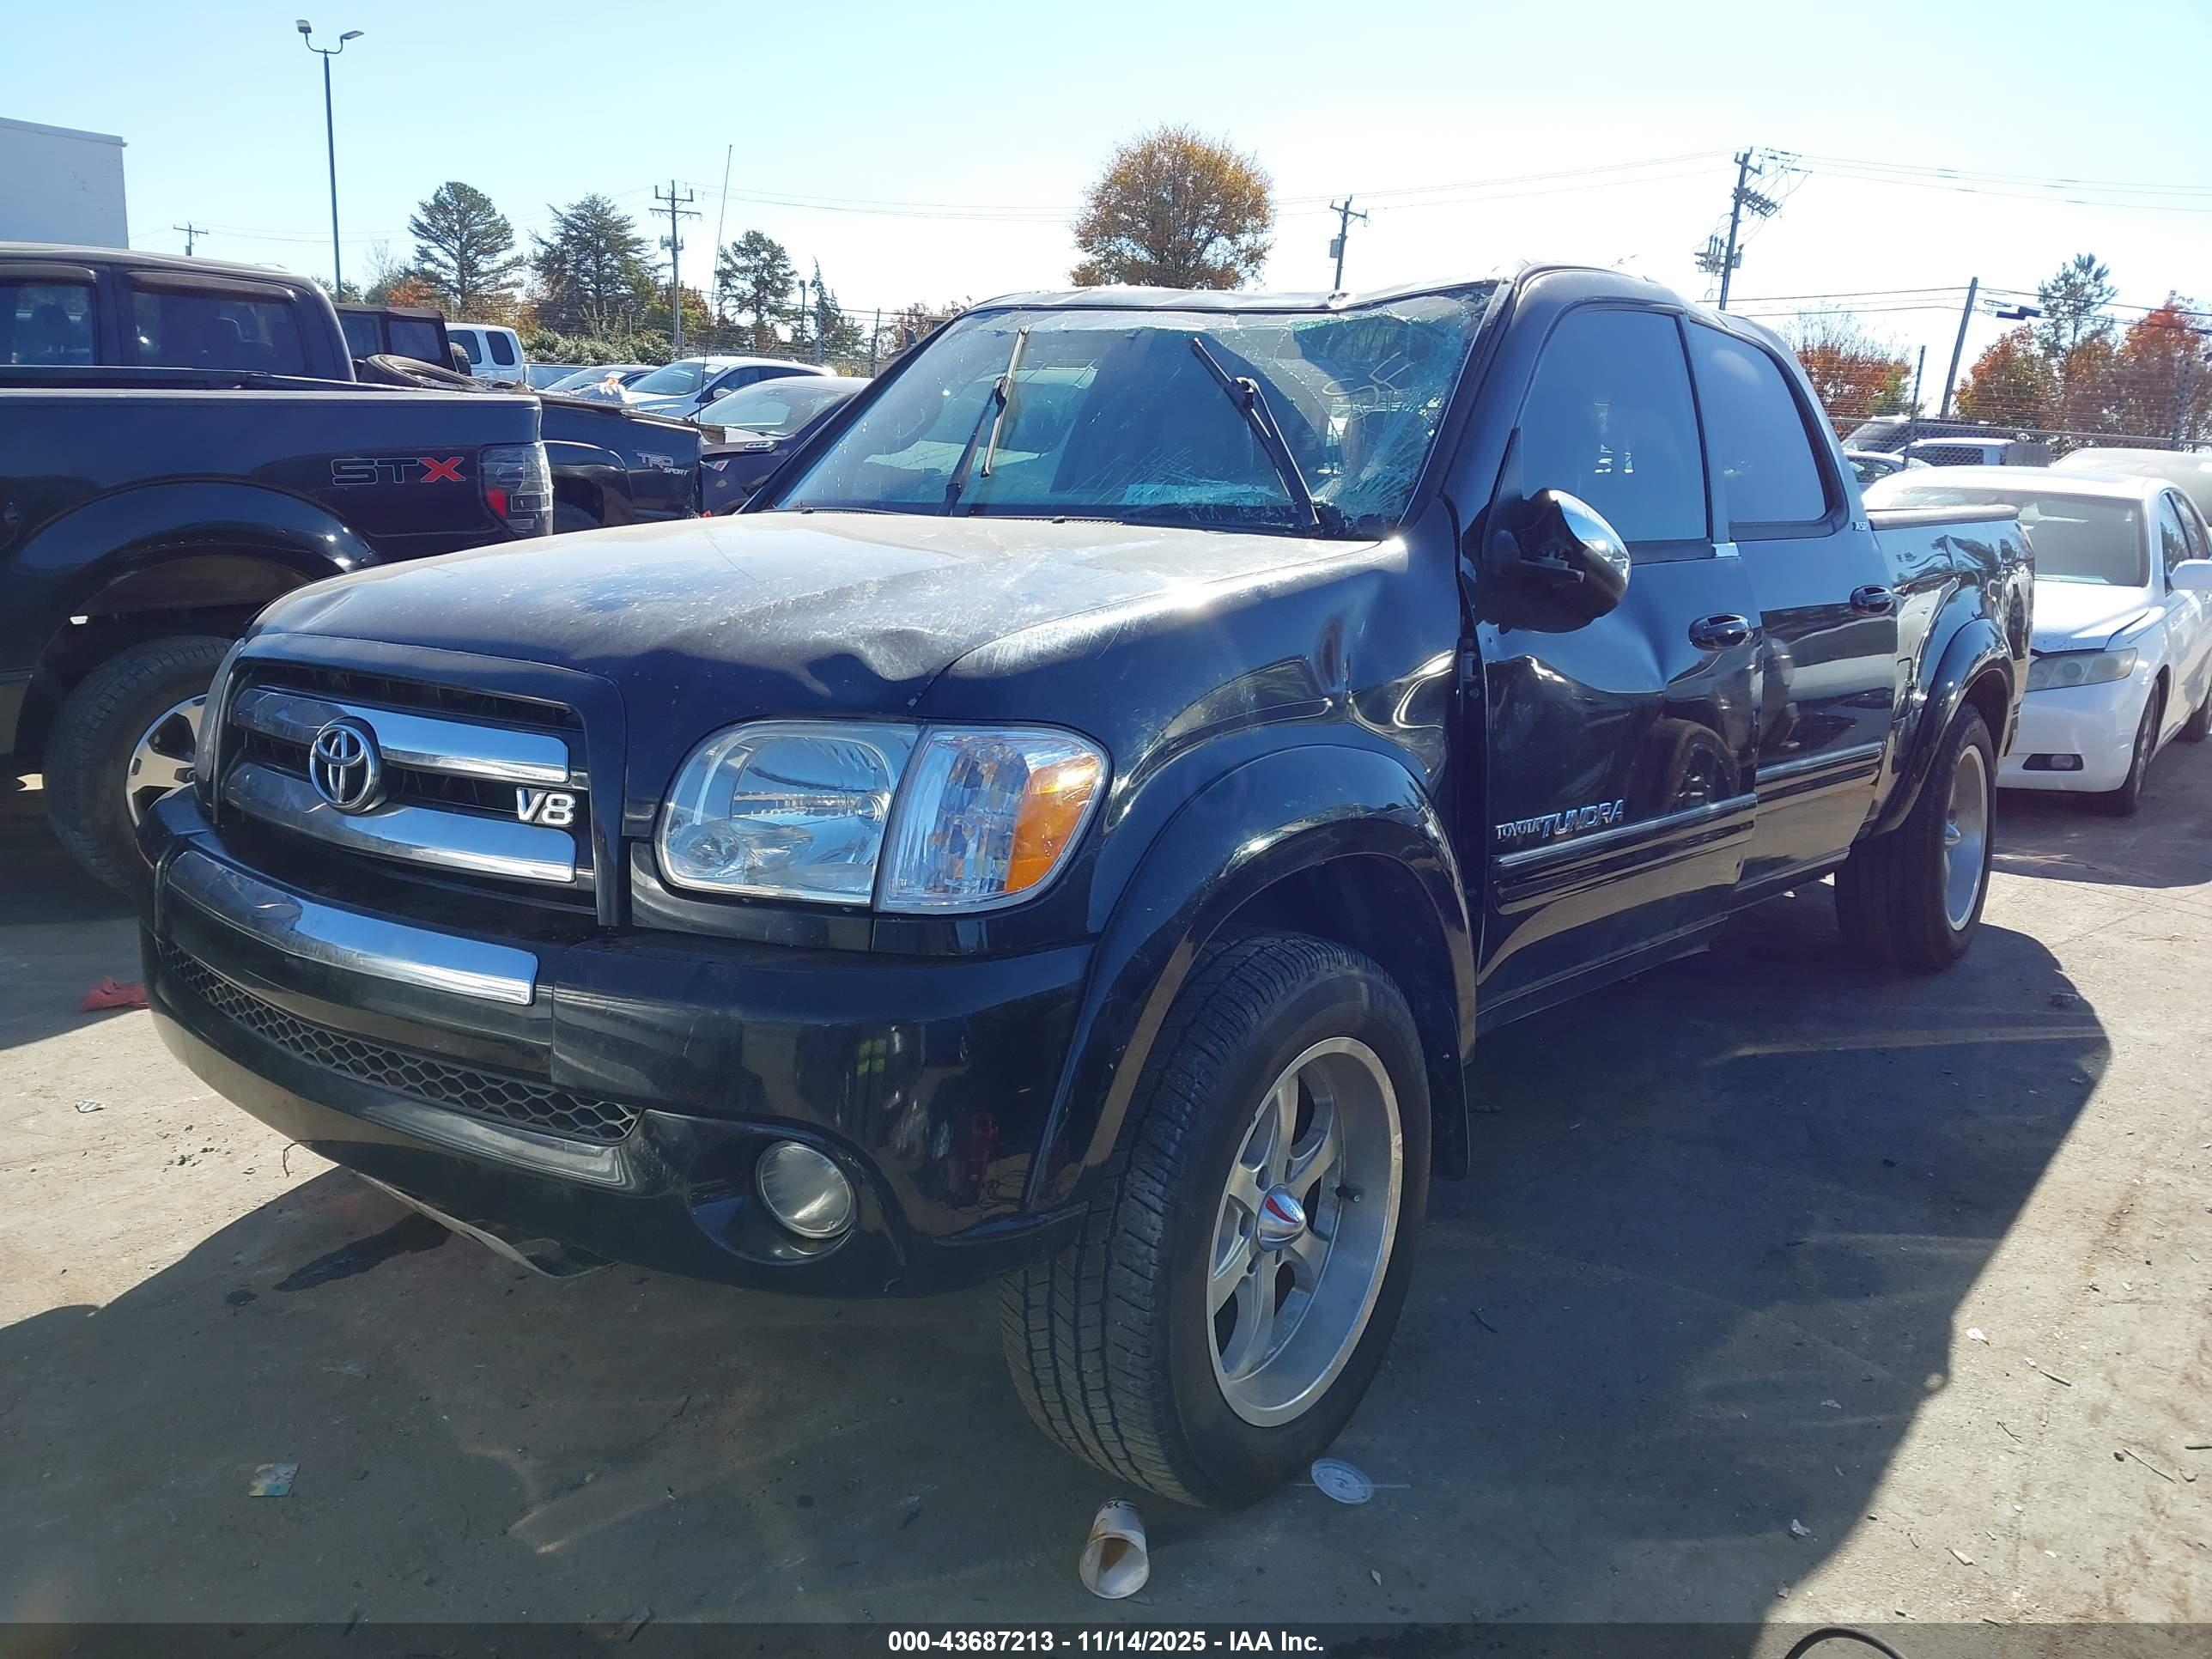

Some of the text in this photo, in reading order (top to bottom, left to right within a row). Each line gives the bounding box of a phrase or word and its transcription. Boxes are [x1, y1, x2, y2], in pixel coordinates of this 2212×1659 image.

[331, 457, 466, 486] STX
[634, 450, 674, 469] TRD
[662, 466, 690, 476] SPORT
[516, 787, 576, 825] V8
[1495, 799, 1624, 840] TOYOTA TUNDRA
